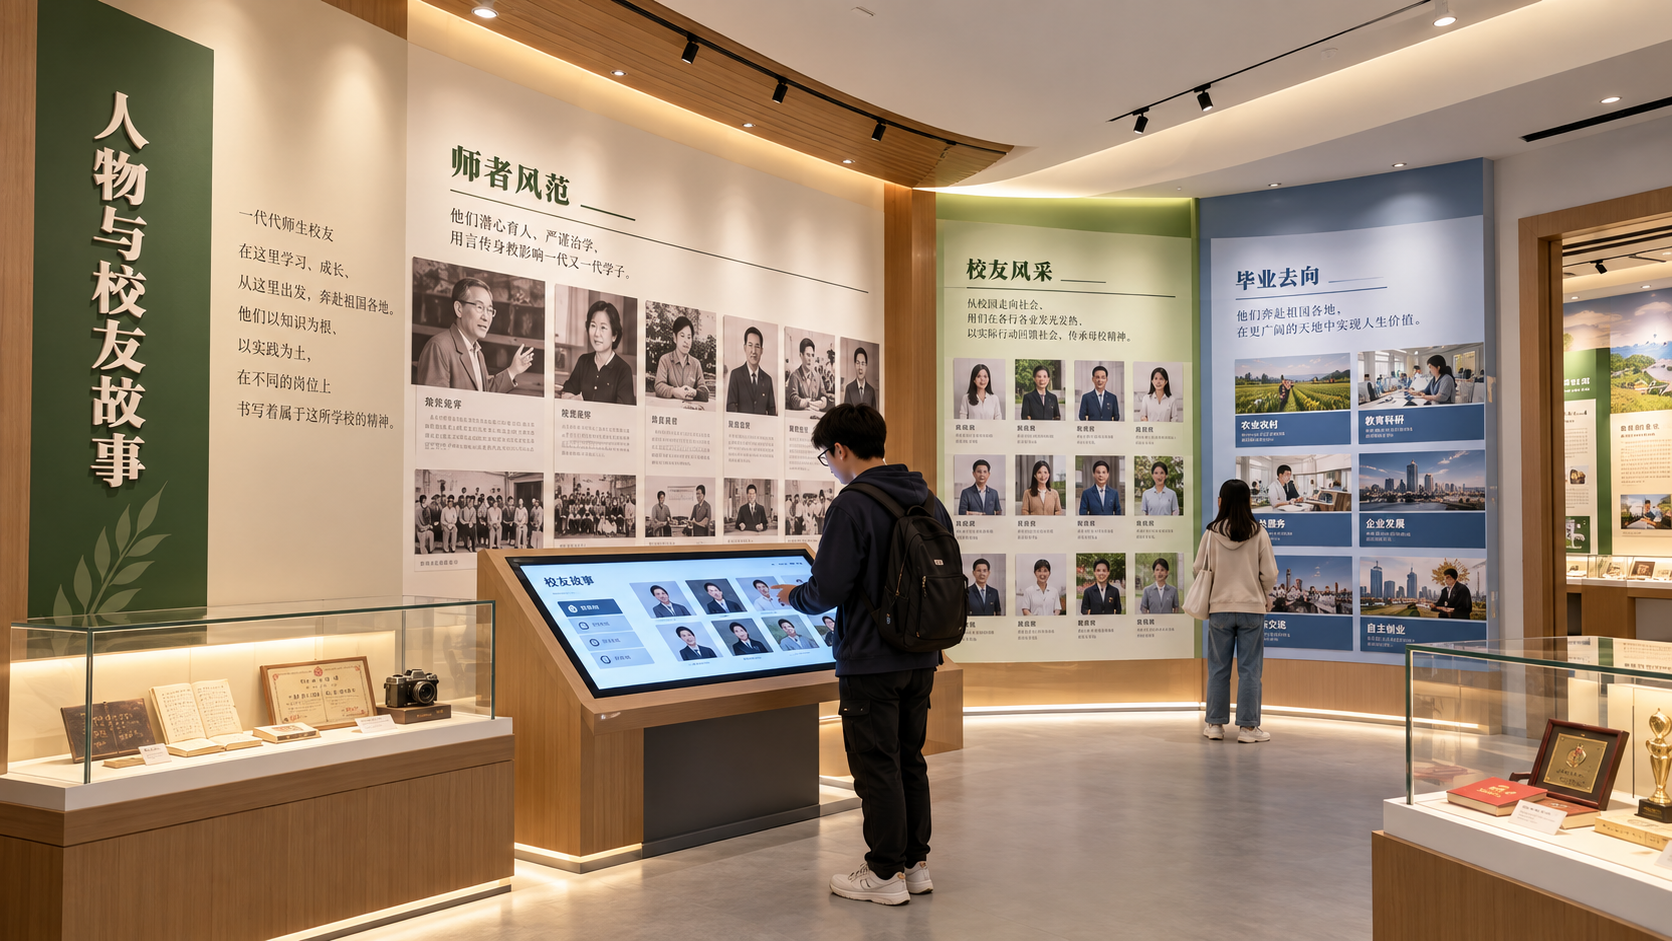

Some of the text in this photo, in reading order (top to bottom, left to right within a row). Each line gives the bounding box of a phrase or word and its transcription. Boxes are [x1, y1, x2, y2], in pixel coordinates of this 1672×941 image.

[451, 145, 571, 206] 师者风范
[238, 209, 334, 242] 一代代师生校友
[238, 243, 349, 279] 在这里学习、成长、
[965, 258, 1053, 282] 校友风采
[90, 91, 149, 488] 人物与校友故事
[1235, 265, 1320, 291] 毕业去向
[238, 274, 394, 316] 从这里出发，奔赴祖国各地。
[238, 305, 337, 336] 他们以知识为根、
[238, 337, 312, 363] 以实践为土，
[237, 368, 332, 394] 在不同的岗位上
[237, 400, 394, 430] 书写着属于这所学校的精神。
[1365, 518, 1405, 529] 企业发展
[1367, 622, 1406, 635] 自主创业
